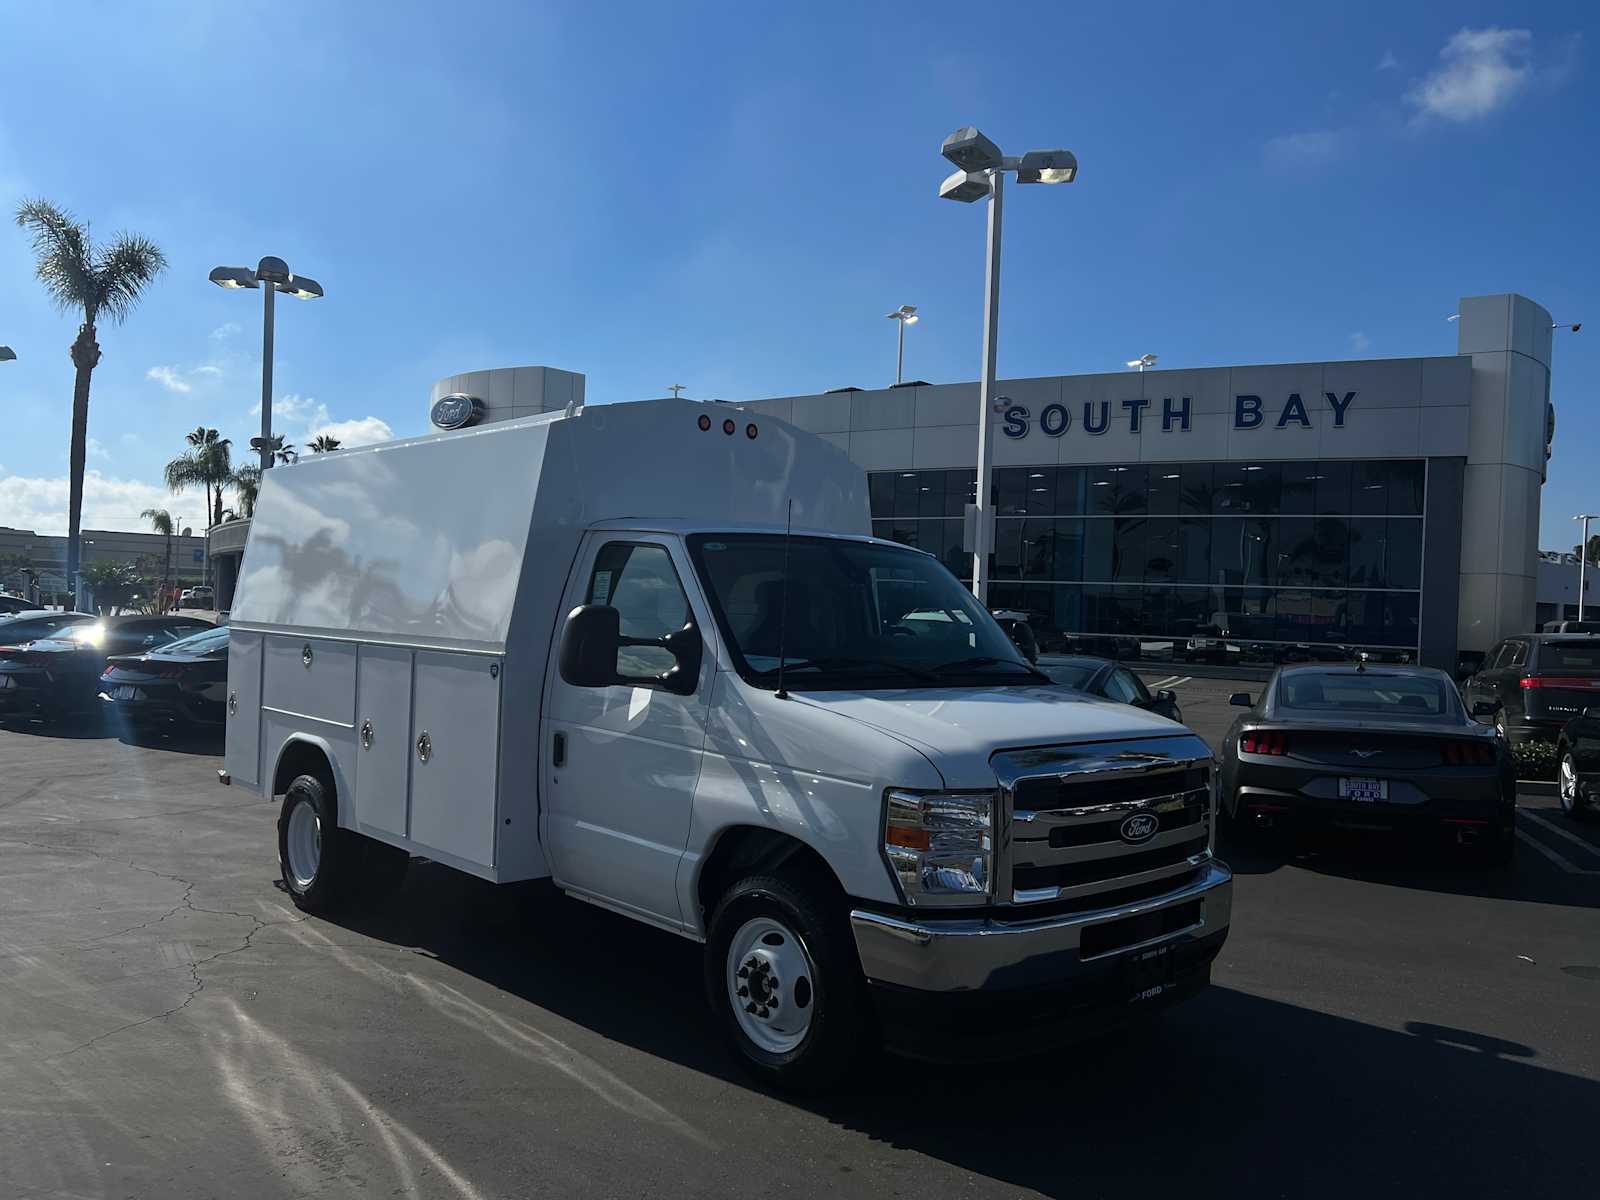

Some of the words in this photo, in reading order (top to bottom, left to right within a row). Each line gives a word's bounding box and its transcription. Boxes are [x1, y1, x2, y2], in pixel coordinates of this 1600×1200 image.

[1002, 397, 1193, 440] SOUTH
[1232, 391, 1358, 430] BAY
[1128, 818, 1153, 837] Ford
